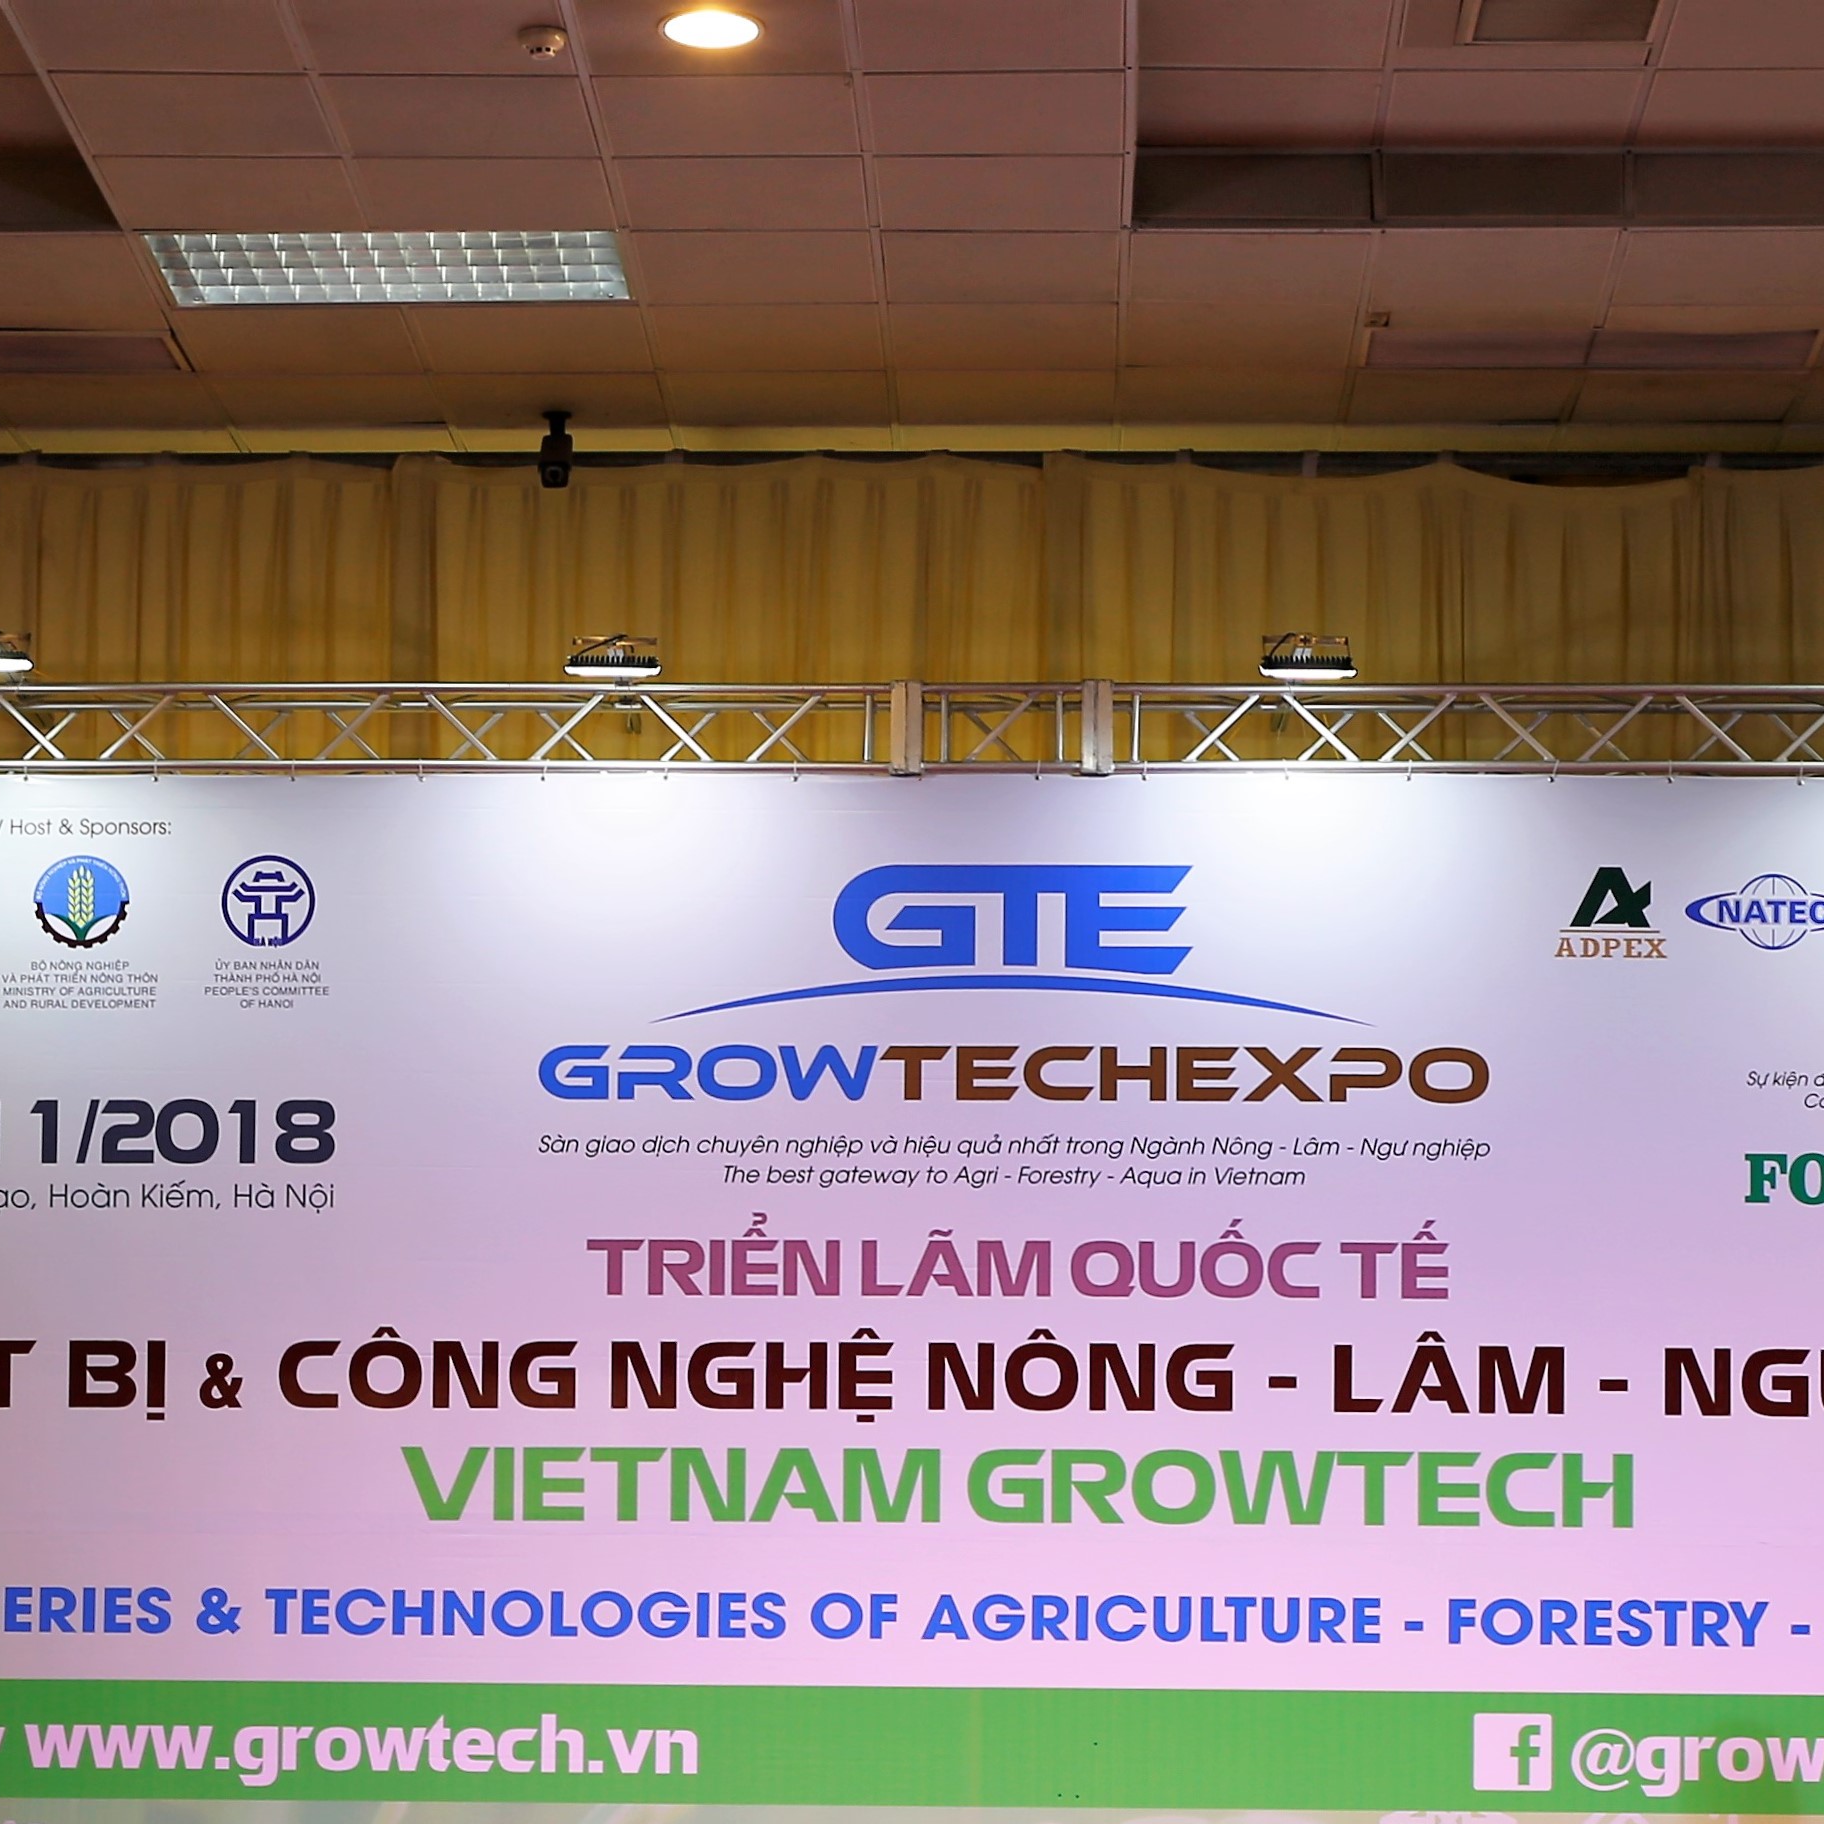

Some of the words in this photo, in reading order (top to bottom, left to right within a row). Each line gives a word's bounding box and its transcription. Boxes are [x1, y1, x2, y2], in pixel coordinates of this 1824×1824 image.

[10, 819, 52, 836] Host
[58, 819, 73, 835] &
[79, 818, 172, 839] Sponsors:
[832, 864, 1194, 974] GTE
[1554, 938, 1668, 959] ADPEX
[49, 959, 83, 971] NÔNG
[233, 961, 257, 971] BAN
[260, 959, 293, 971] NHÂN
[295, 959, 320, 971] DÂN
[1, 972, 17, 984] VÀ
[20, 972, 51, 984] PHÁT
[90, 972, 123, 984] NÔNG
[127, 972, 159, 984] THÔN
[213, 972, 253, 983] THÀNH
[282, 972, 299, 983] HÀ
[2, 986, 56, 997] MINISTRY
[59, 986, 75, 997] OF
[77, 986, 157, 997] AGRICULTURE
[262, 986, 330, 997] COMMITTEE
[2, 999, 28, 1009] AND
[30, 999, 68, 1009] RURAL
[70, 999, 157, 1009] DEVELOPMENT
[239, 999, 256, 1009] OF
[258, 999, 294, 1009] HANOI
[538, 1044, 1491, 1105] GROWTECHEXPO
[1746, 1070, 1770, 1089] Sự
[1772, 1071, 1809, 1090] kiện
[538, 1134, 579, 1154] Sàn
[585, 1139, 636, 1159] giao
[642, 1135, 690, 1158] dịch
[696, 1135, 779, 1159] chuyên
[785, 1136, 864, 1159] nghiệp
[870, 1135, 899, 1154] và
[903, 1135, 951, 1158] hiệu
[957, 1133, 1003, 1158] quả
[1007, 1133, 1061, 1155] nhất
[1066, 1137, 1125, 1160] trong
[1130, 1136, 1205, 1160] Ngành
[1211, 1136, 1273, 1161] Nông
[1293, 1137, 1340, 1156] Lâm
[1360, 1138, 1409, 1161] Ngư
[1413, 1138, 1491, 1162] nghiệp
[724, 1165, 761, 1184] The
[766, 1165, 815, 1184] best
[818, 1166, 921, 1189] gateway
[926, 1166, 948, 1185] to
[953, 1165, 1000, 1189] Agri
[1017, 1166, 1102, 1189] Forestry
[1119, 1167, 1183, 1189] Aqua
[1187, 1167, 1207, 1185] in
[1214, 1167, 1306, 1186] Vietnam
[49, 1182, 130, 1209] Hoàn
[141, 1179, 222, 1214] Kiếm,
[234, 1182, 275, 1209] Hà
[285, 1183, 335, 1215] Nội
[586, 1211, 841, 1298] TRIỂN
[860, 1227, 1052, 1298] LÃM
[1069, 1218, 1322, 1302] QUỐC
[1339, 1218, 1451, 1302] TẾ
[68, 1339, 166, 1421] BỊ
[199, 1352, 243, 1409] &
[278, 1326, 578, 1410] CÔNG
[610, 1327, 895, 1423] NGHỆ
[927, 1328, 1235, 1412] NÔNG
[1268, 1375, 1298, 1389] -
[1333, 1330, 1566, 1415] LÂM
[1599, 1378, 1629, 1392] -
[400, 1445, 942, 1524] VIETNAM
[966, 1448, 1634, 1529] GROWTECH
[195, 1587, 242, 1635] &
[264, 1588, 787, 1640] TECHNOLOGIES
[810, 1592, 898, 1640] OF
[921, 1593, 1382, 1644] AGRICULTURE
[1448, 1597, 1770, 1648] FORESTRY
[23, 1713, 700, 1788] www.growtech.vn
